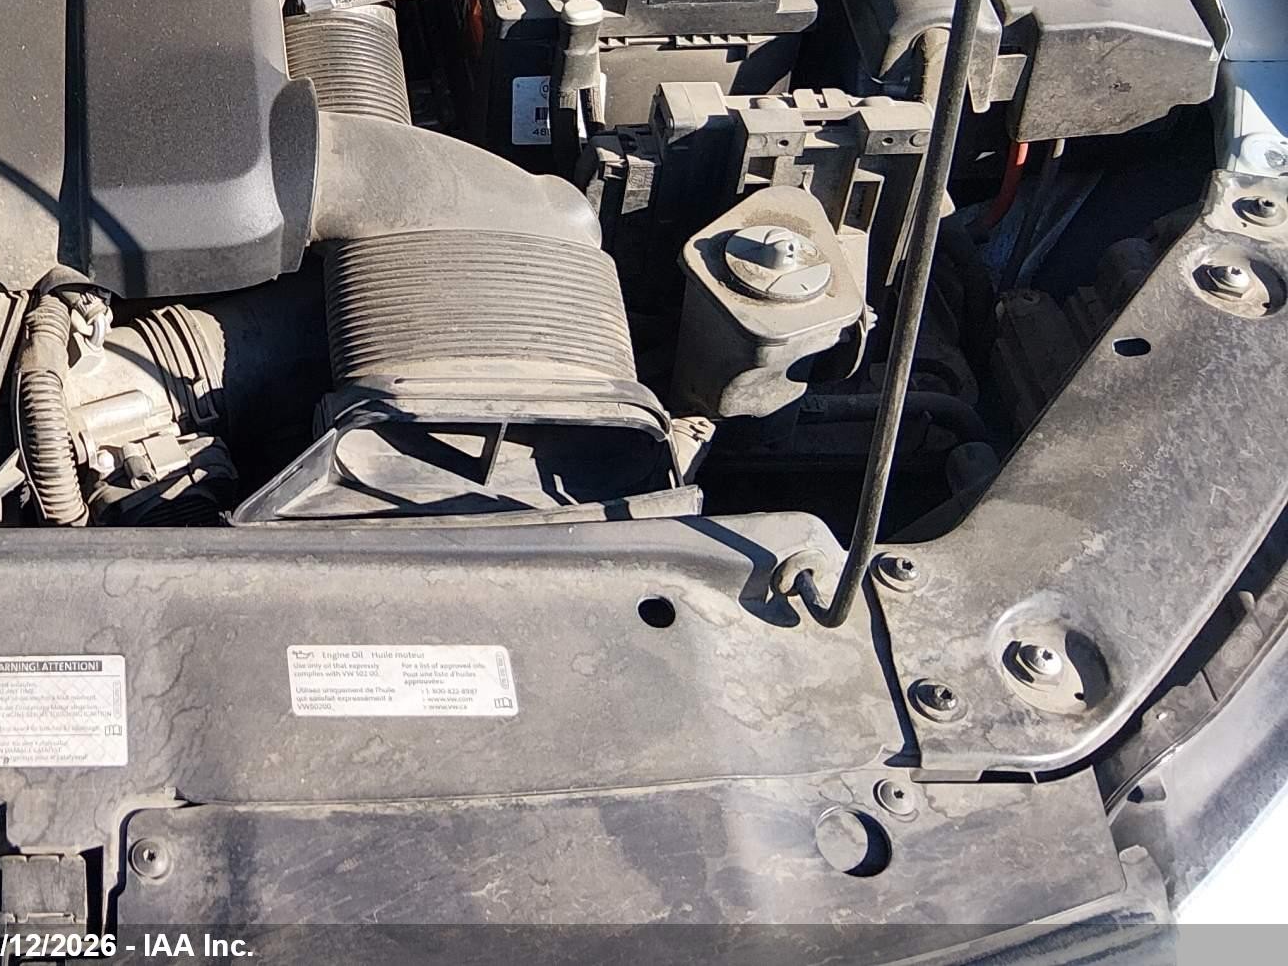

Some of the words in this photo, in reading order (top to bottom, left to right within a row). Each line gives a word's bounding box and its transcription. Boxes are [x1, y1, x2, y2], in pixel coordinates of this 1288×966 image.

[322, 651, 349, 660] Engine
[351, 651, 363, 659] Oil
[372, 651, 393, 659] Huile
[42, 661, 100, 671] ATTENTION!
[307, 663, 321, 671] only
